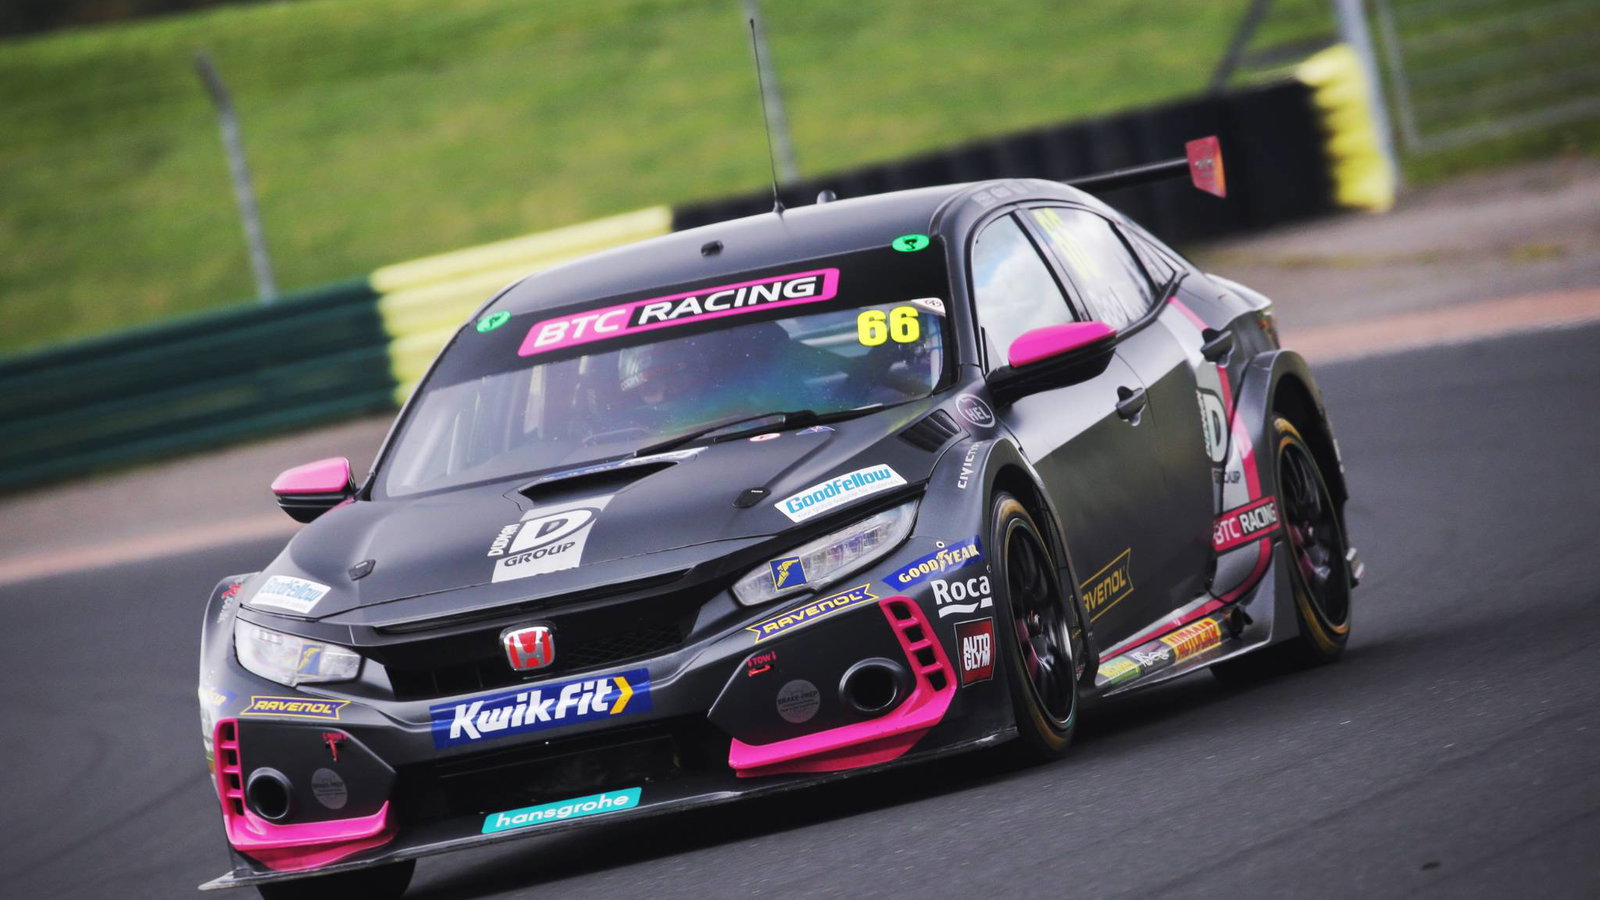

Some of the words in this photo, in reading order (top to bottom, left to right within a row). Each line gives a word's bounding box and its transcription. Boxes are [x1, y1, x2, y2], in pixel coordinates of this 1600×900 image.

[534, 309, 626, 347] BTC
[637, 276, 817, 325] RACING
[857, 306, 919, 347] 66
[965, 406, 990, 421] HEL
[1213, 517, 1241, 545] BTC
[504, 541, 576, 567] GROUP
[898, 543, 980, 583] GOODYEAR
[930, 575, 991, 605] Roca
[1082, 568, 1127, 613] AVENOL
[764, 592, 864, 634] RAVENOL
[963, 633, 990, 651] AUTO
[752, 653, 771, 665] TOW
[964, 649, 990, 671] GLYM
[253, 700, 333, 714] RAVENOL
[450, 678, 613, 740] KwikFit
[496, 794, 629, 828] hansgrohe
